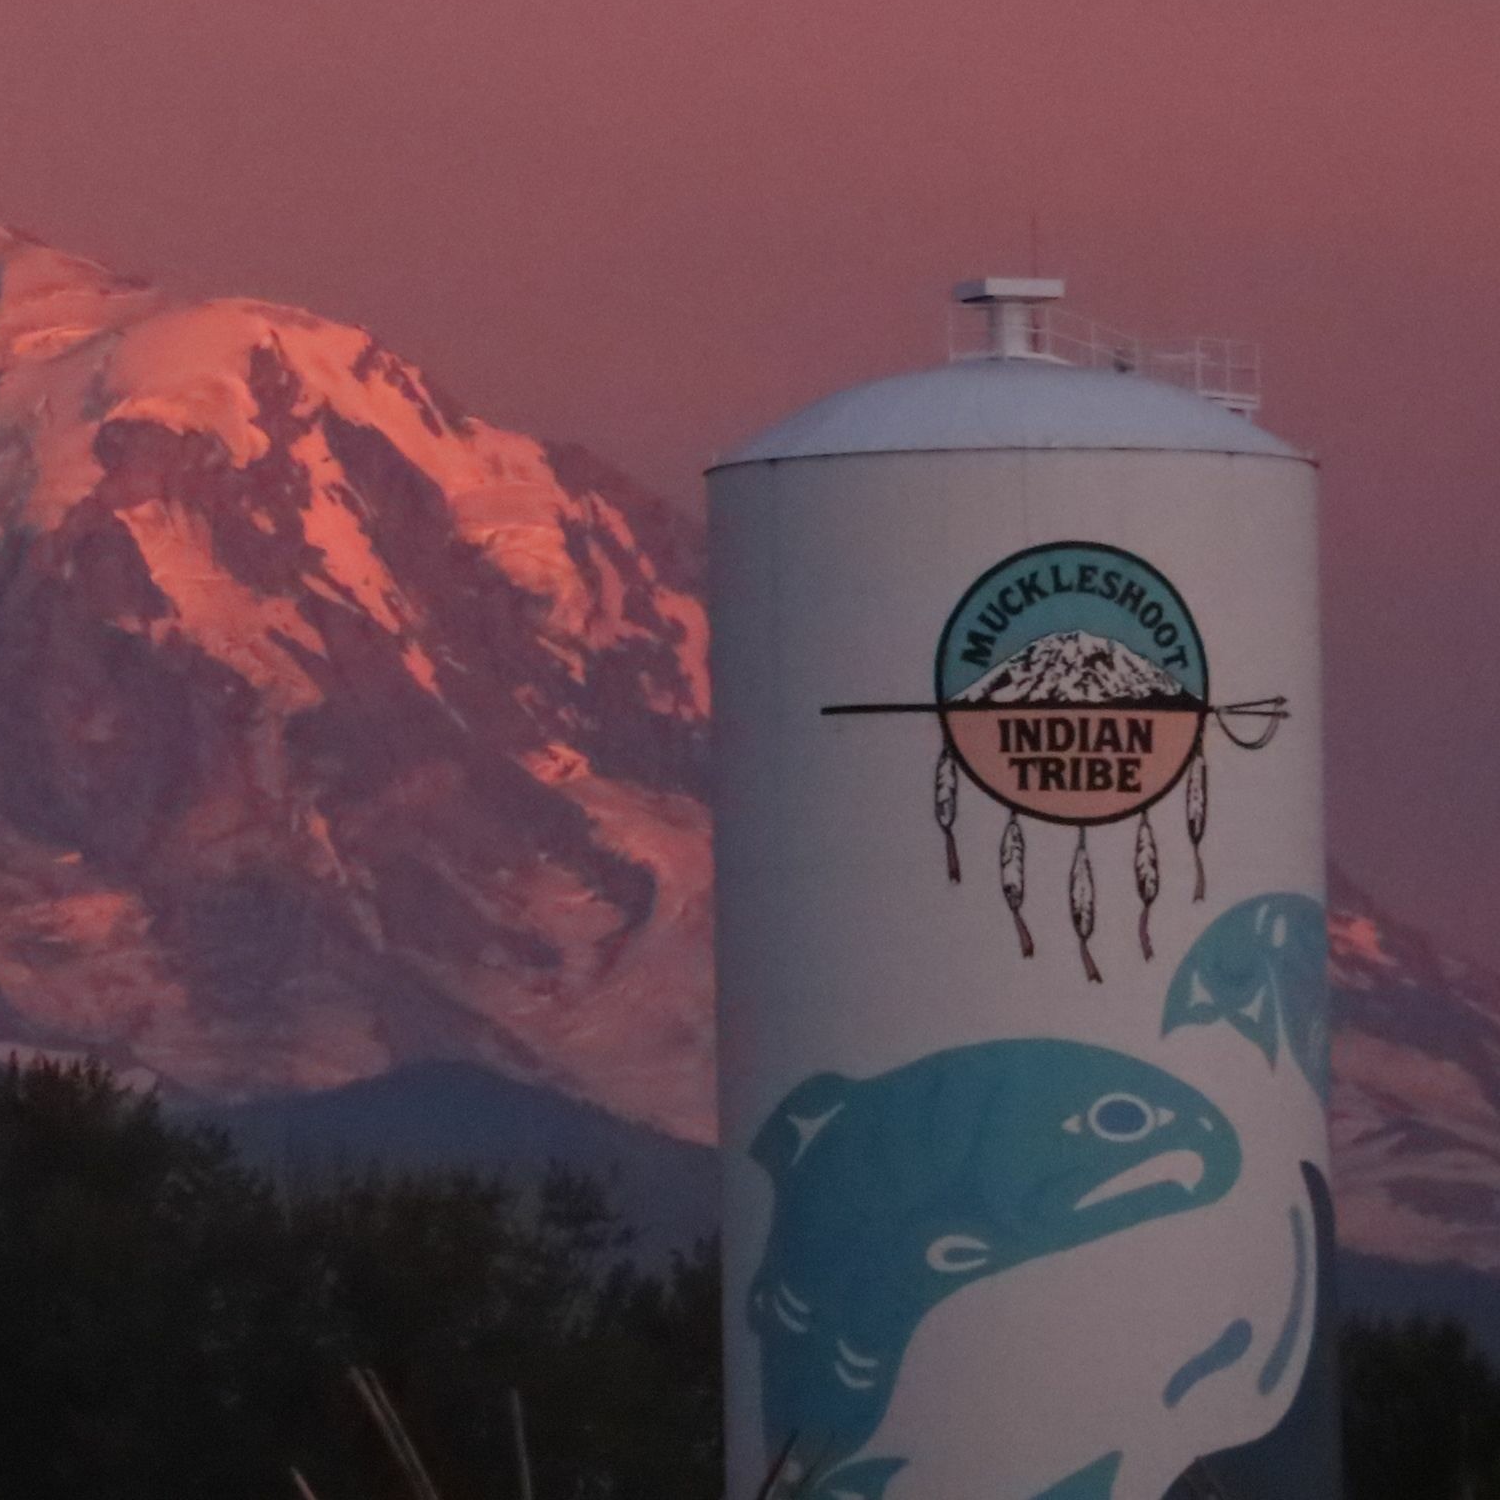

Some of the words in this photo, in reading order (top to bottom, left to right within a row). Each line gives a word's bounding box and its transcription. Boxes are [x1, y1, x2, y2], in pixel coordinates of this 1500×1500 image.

[960, 564, 1189, 670] MUCKLESHOOT
[997, 717, 1154, 754] INDIAN
[1008, 757, 1142, 793] TRIBE
